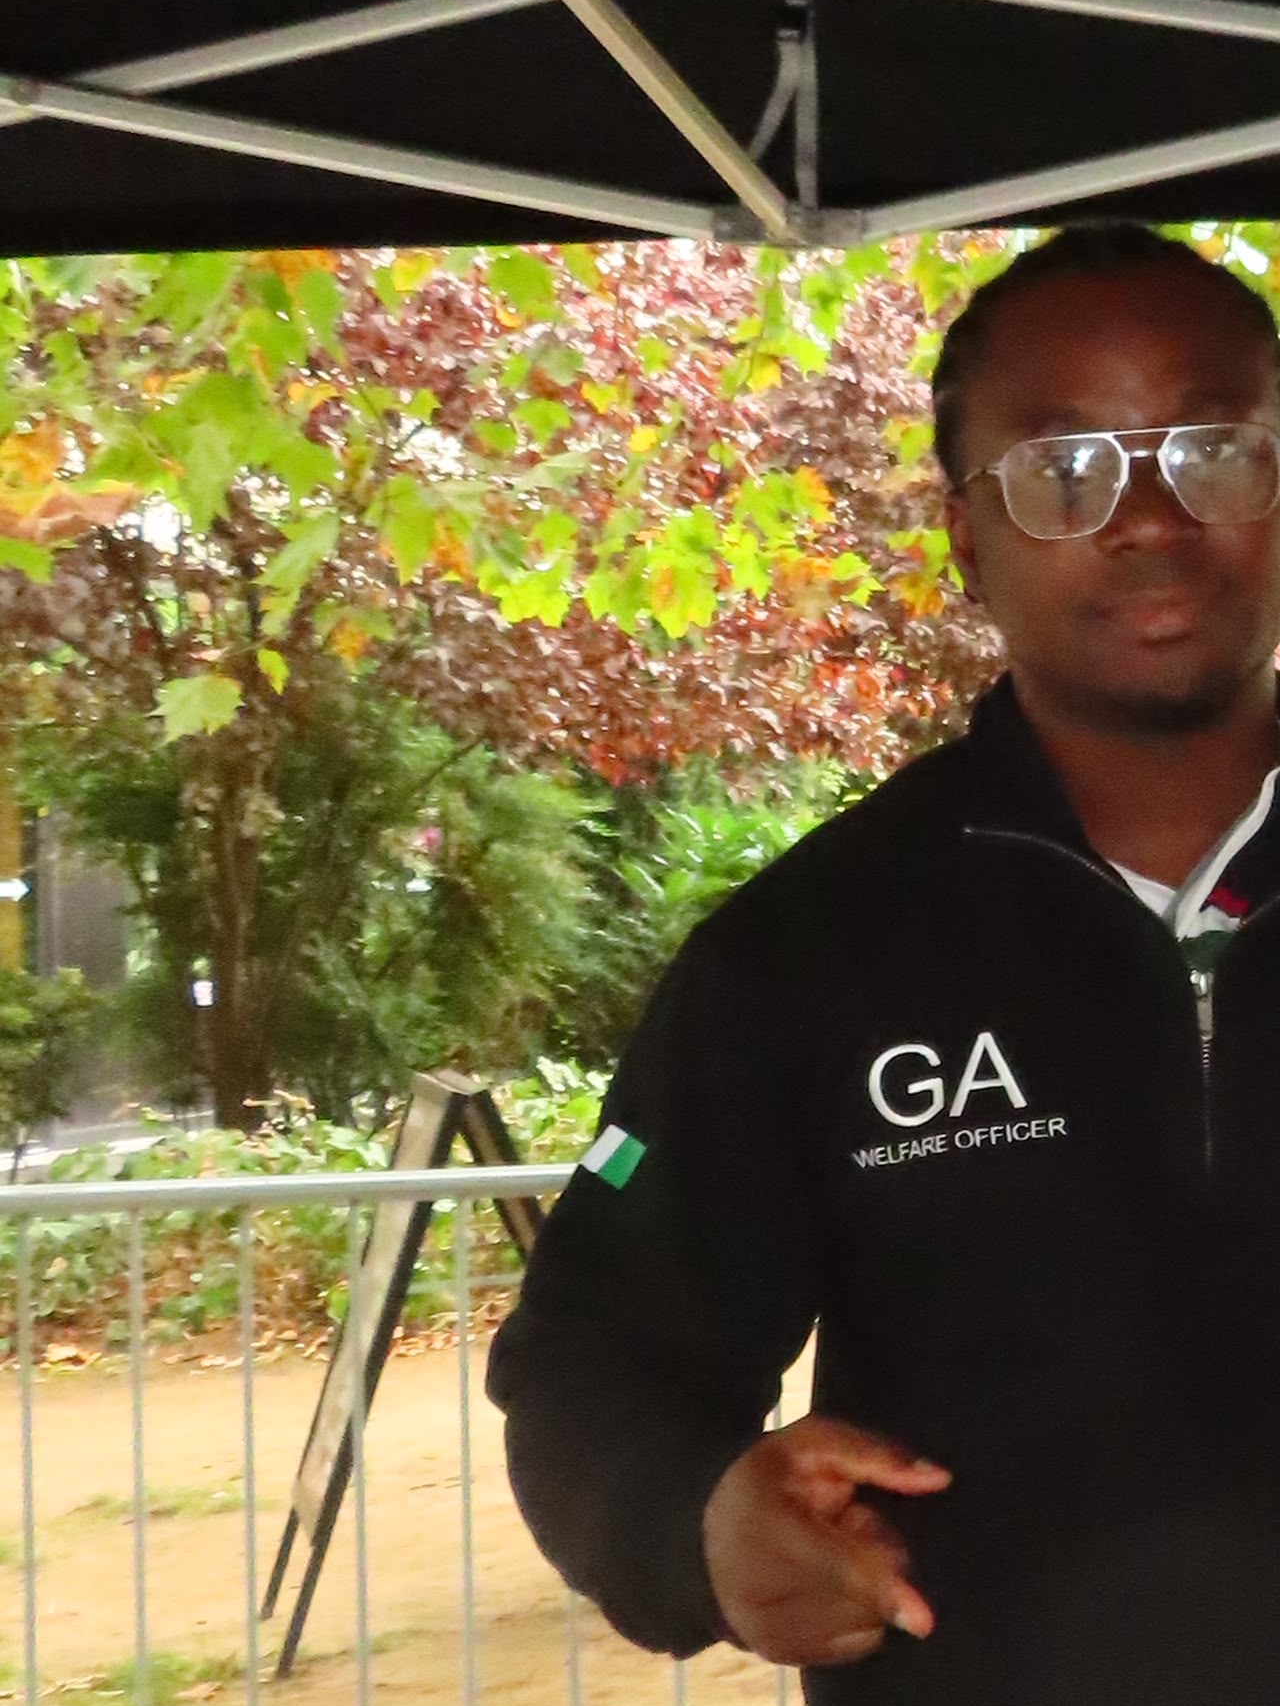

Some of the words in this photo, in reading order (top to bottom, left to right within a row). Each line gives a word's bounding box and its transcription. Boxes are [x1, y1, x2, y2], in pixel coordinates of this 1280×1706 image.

[867, 1031, 1029, 1129] GA
[851, 1133, 949, 1169] WELFARE
[953, 1117, 1068, 1150] OFFICER
